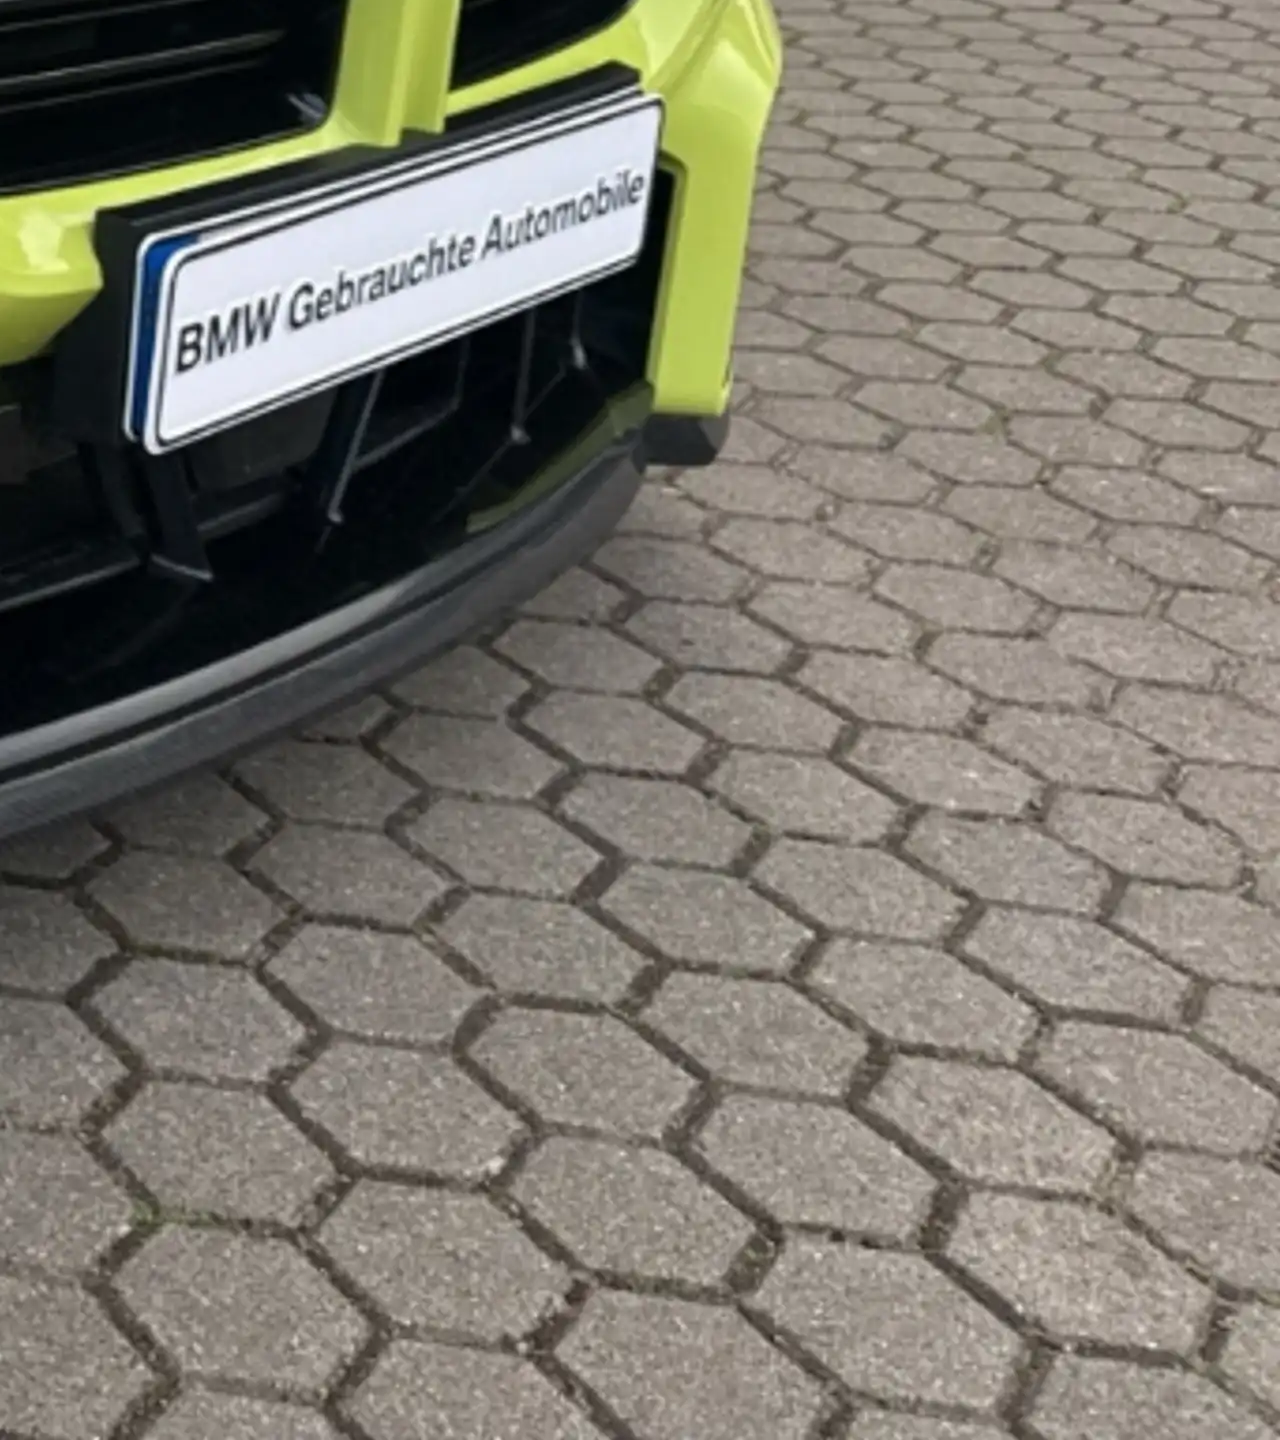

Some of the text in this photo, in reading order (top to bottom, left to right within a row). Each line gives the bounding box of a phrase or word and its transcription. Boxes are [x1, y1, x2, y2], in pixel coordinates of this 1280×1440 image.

[176, 169, 645, 373] BMW Gebrauchte Automobile
